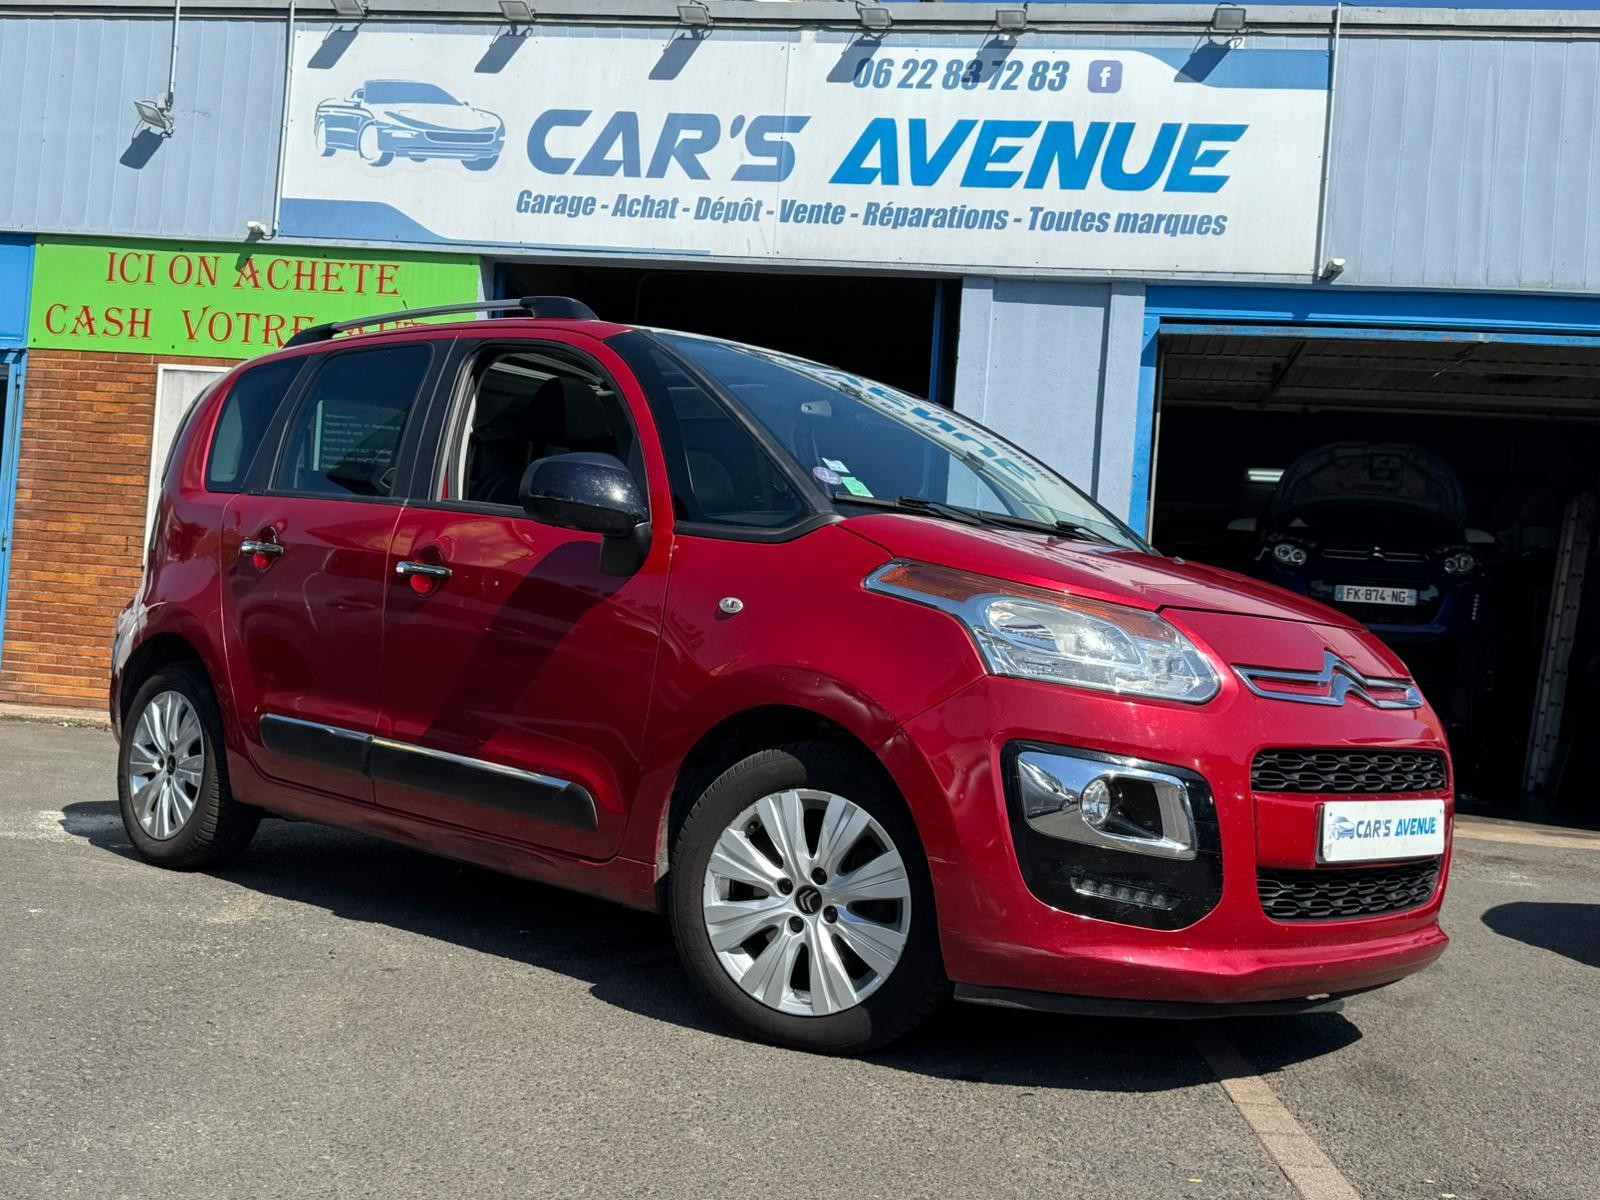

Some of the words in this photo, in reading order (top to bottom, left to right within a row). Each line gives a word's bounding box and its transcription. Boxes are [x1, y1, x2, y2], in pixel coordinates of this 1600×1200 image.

[853, 57, 896, 89] 06
[897, 58, 938, 89] 22
[941, 59, 984, 90] 83
[986, 60, 1024, 91] 72
[1027, 60, 1071, 92] 83
[526, 108, 812, 183] CAR'S
[828, 117, 1250, 193] AVENUE
[516, 190, 596, 218] Garage
[611, 194, 679, 219] Achat
[694, 196, 763, 224] Dépôt
[779, 200, 845, 225] Vente
[863, 202, 1009, 229] Réparations
[1028, 207, 1111, 233] Toutes
[1114, 213, 1228, 237] marques
[106, 252, 156, 285] ICI
[168, 254, 221, 288] ON
[233, 257, 401, 297] ACHETE
[45, 303, 153, 339] CASH
[1346, 587, 1406, 603] FK-874-NG
[1356, 818, 1392, 838] CAR'S
[1394, 817, 1436, 836] AVENUE
